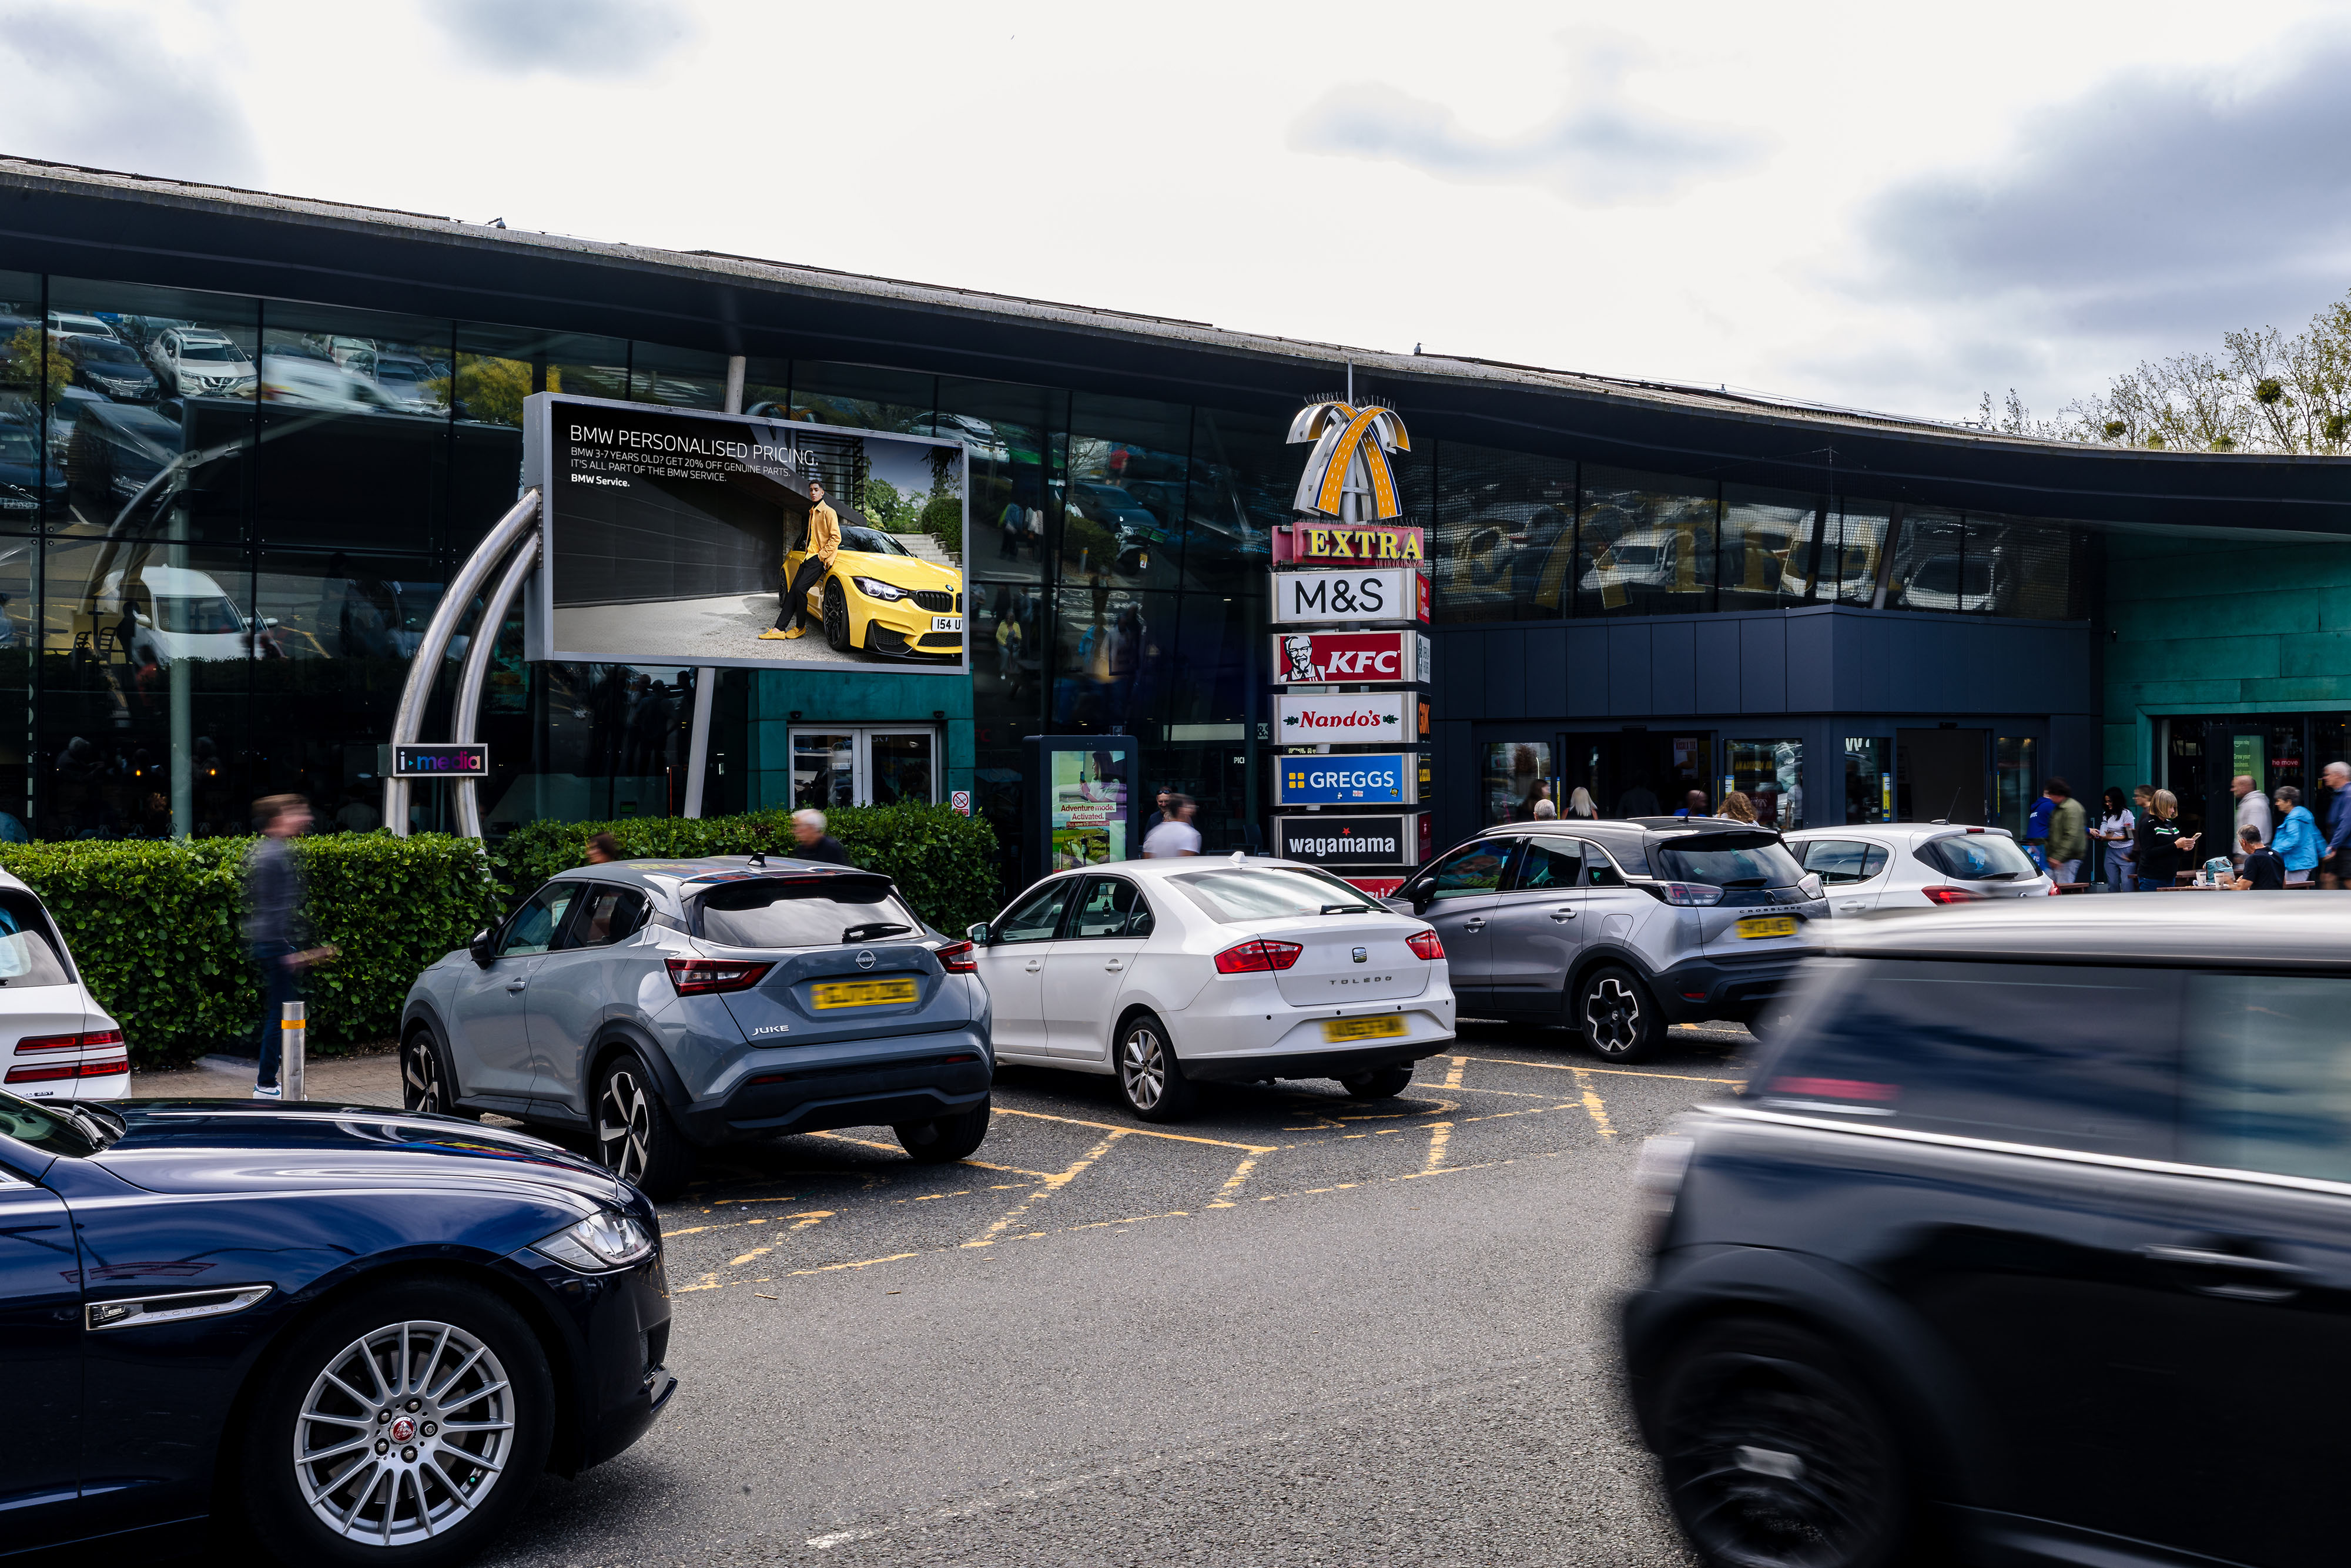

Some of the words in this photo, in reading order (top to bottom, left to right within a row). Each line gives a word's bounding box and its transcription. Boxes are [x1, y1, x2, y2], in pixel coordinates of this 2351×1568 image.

[571, 424, 614, 444] BMW
[619, 430, 748, 458] PERSONALISED
[753, 444, 818, 465] PRICING.
[571, 447, 594, 457] BMW
[595, 449, 609, 459] 3-7
[610, 450, 639, 462] YEARS
[641, 454, 664, 464] OLD?
[665, 456, 683, 466] GET
[685, 458, 704, 468] 20%
[705, 460, 723, 470] OFF
[724, 462, 761, 474] GENUINE
[763, 466, 791, 477] PARTS.
[571, 458, 587, 469] IT'S
[589, 461, 607, 470] ALL
[609, 463, 632, 473] PART
[634, 464, 645, 474] OF
[647, 465, 665, 476] THE
[667, 468, 688, 478] BMW
[690, 470, 727, 482] SERVICE.
[571, 473, 594, 484] BMW
[595, 476, 630, 487] Service.
[1308, 529, 1423, 560] EXTRA
[1295, 578, 1384, 614] M&S
[955, 619, 963, 630] U
[1326, 651, 1398, 674] KFC
[1299, 710, 1381, 728] Nando's
[1310, 770, 1395, 788] GREGGS
[1289, 837, 1395, 857] wagamama
[1329, 976, 1392, 985] TOLEDO
[751, 1024, 790, 1036] JUKE
[146, 1305, 220, 1319] JAGUAR
